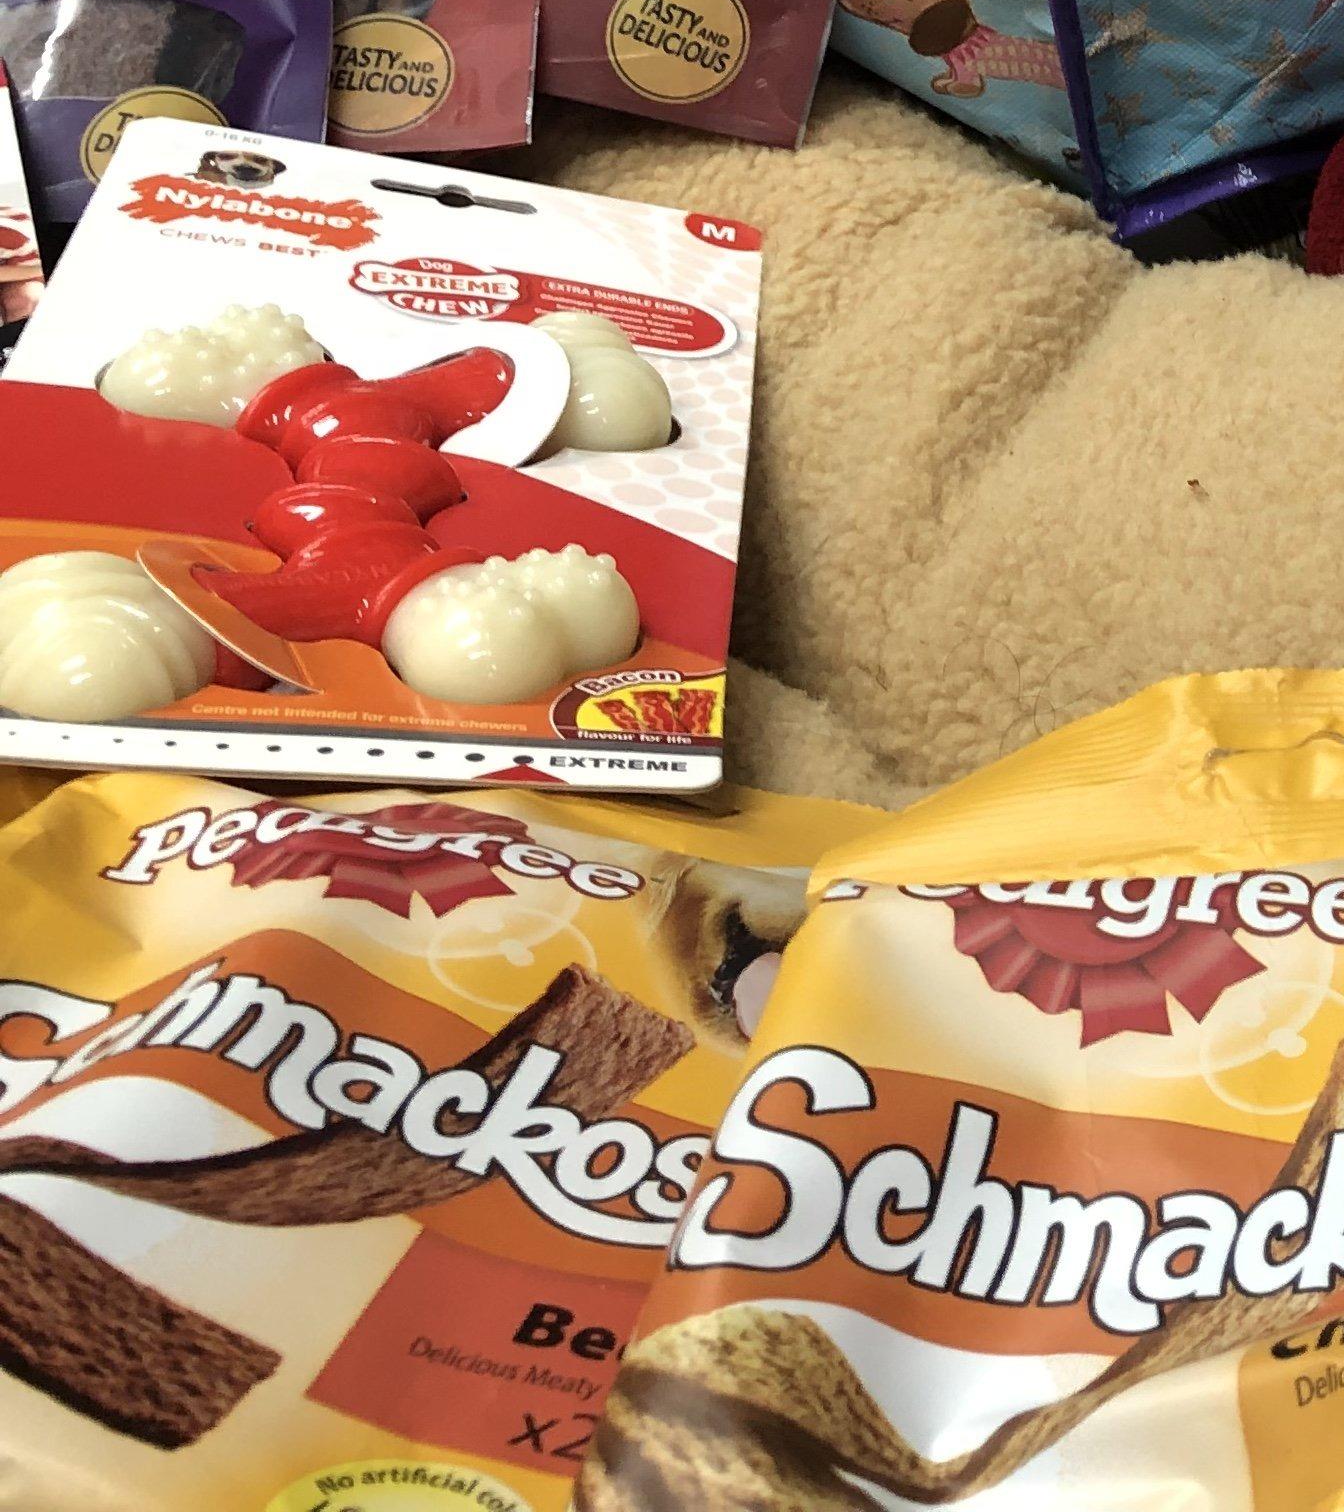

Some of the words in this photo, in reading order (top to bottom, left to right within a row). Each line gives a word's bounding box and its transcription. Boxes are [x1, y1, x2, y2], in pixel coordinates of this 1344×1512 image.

[617, 13, 731, 74] DELICIOUS
[695, 28, 730, 48] AND
[332, 44, 404, 70] TASTY
[155, 185, 353, 229] Nylabone
[159, 227, 247, 248] CHEWS
[258, 241, 321, 258] BEST
[701, 221, 736, 243] M
[418, 258, 453, 273] Dog
[371, 270, 508, 296] EXTREME
[547, 281, 591, 297] EXTRA
[391, 293, 490, 317] CHEW
[581, 670, 678, 694] Bacon
[550, 754, 689, 773] EXTREME
[511, 1301, 626, 1362] Be
[406, 1335, 519, 1381] Delicious
[523, 1364, 602, 1401] Meaty
[314, 1473, 355, 1496] No
[362, 1466, 480, 1497] artificial
